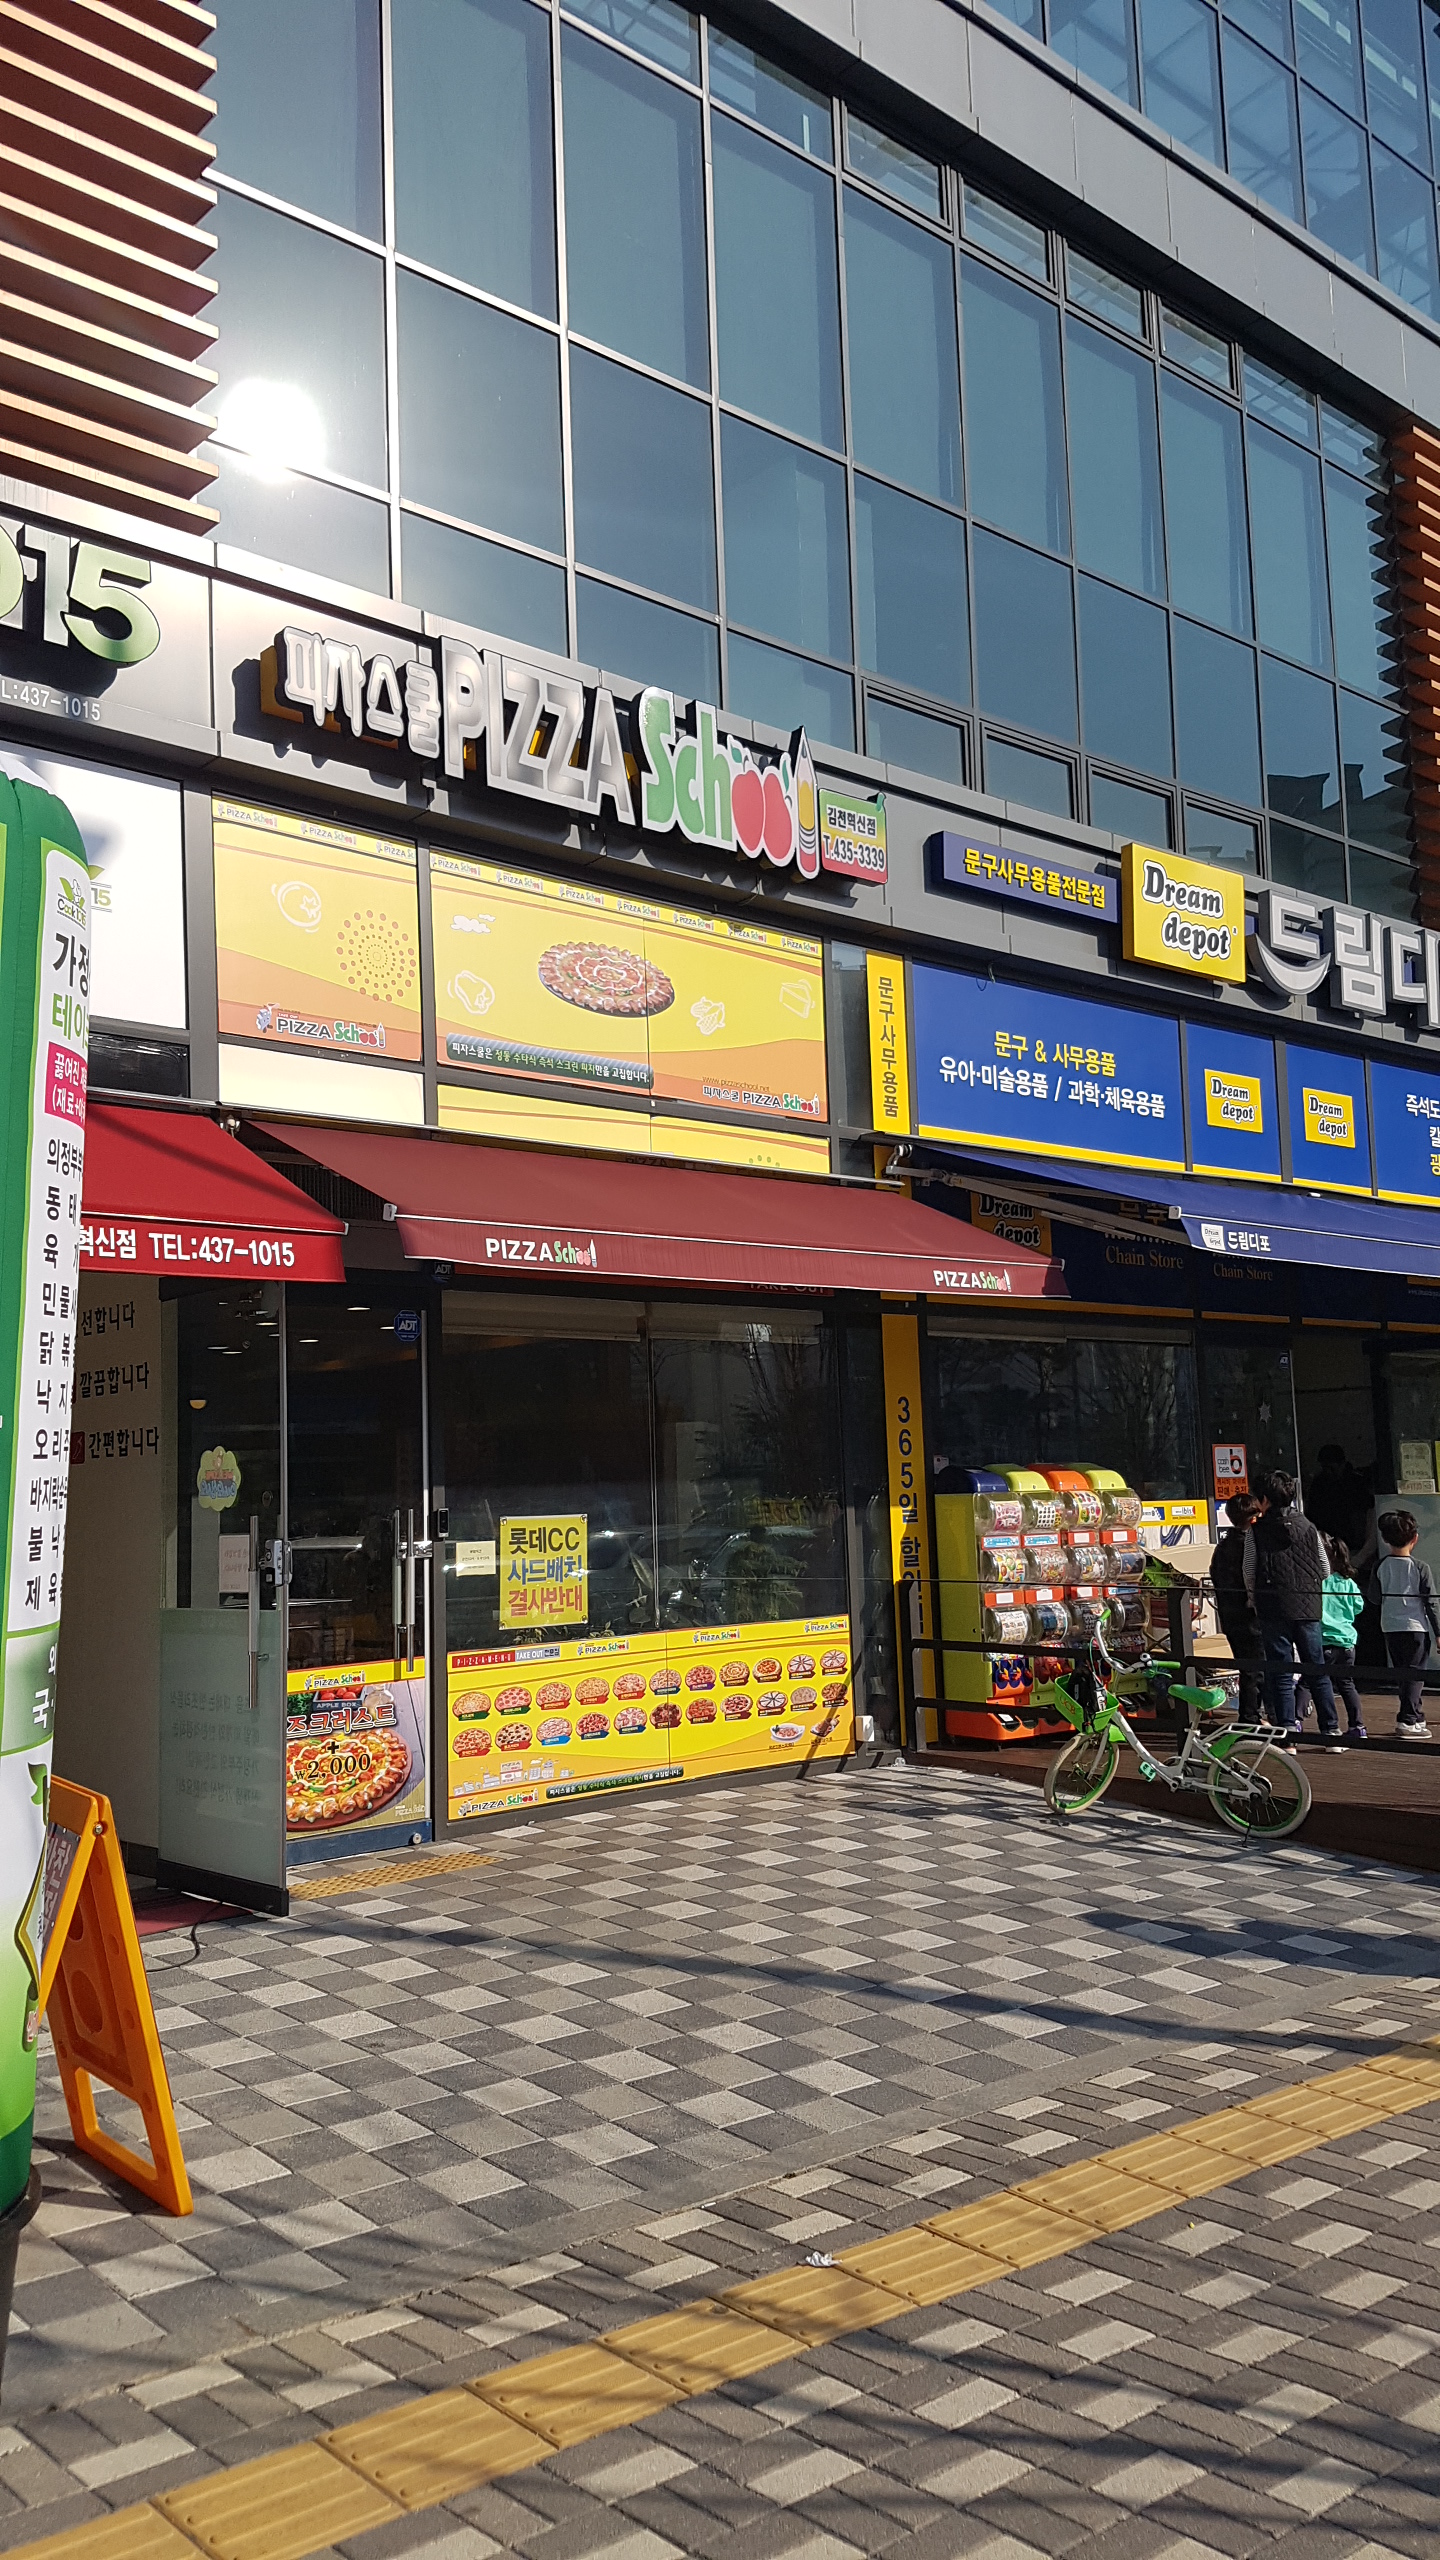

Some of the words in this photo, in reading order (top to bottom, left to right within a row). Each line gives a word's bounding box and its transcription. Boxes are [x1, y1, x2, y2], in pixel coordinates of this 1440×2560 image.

[284, 627, 441, 758] 피자스쿨
[441, 637, 634, 826] PIZZA
[638, 686, 820, 880] School
[226, 807, 252, 821] PIZZA
[826, 805, 878, 838] 김천혁신점
[309, 826, 333, 839] PIZZA
[384, 845, 406, 858] PIZZA
[822, 832, 886, 872] T.435-3339
[438, 859, 459, 871] PIZZA
[503, 875, 523, 886] PIZZA
[963, 847, 1106, 909] 문구사무용품전문점
[1143, 860, 1223, 917] Dream
[91, 887, 112, 907] 15
[565, 889, 585, 901] PIZZA
[623, 903, 641, 914] PIZZA
[787, 940, 803, 950] PIZZA
[1162, 910, 1231, 960] depot
[52, 932, 91, 998] 가정
[277, 1017, 332, 1040] PIZZA
[334, 1021, 385, 1048] School
[877, 976, 899, 1119] 문구사무용품
[994, 1031, 1029, 1058] 문구
[1034, 1039, 1047, 1063] &
[1053, 1042, 1117, 1078] 사무용품
[452, 1042, 493, 1060] 피자스쿨은
[539, 1056, 554, 1069] 즉석
[556, 1059, 579, 1073] 스크린
[612, 1068, 650, 1084] 고집합니다.
[938, 1055, 1049, 1100] 유아·미술용품
[1068, 1078, 1165, 1119] 과학·체육용품
[1210, 1075, 1250, 1101] Dream
[742, 1091, 782, 1108] PIZZA
[783, 1092, 820, 1115] School
[1221, 1101, 1255, 1124] depot
[1308, 1094, 1343, 1118] Dream
[1318, 1119, 1348, 1140] depot
[148, 1231, 296, 1268] TEL:437-1015
[485, 1237, 554, 1262] PIZZA
[554, 1238, 597, 1268] School
[1227, 1231, 1272, 1252] 드림디포
[434, 1264, 452, 1275] ADT
[1105, 1245, 1146, 1269] Chain
[1150, 1252, 1184, 1270] Store
[933, 1269, 981, 1288] PIZZA
[981, 1269, 1012, 1292] School
[1213, 1262, 1244, 1279] Chain
[1246, 1265, 1274, 1282] Store
[80, 1301, 136, 1338] 선합니다
[398, 1319, 417, 1331] ADT
[79, 1361, 150, 1398] 깔끔합니다
[88, 1426, 160, 1460] 간편합니다
[508, 1526, 580, 1555] 롯데CC
[507, 1554, 584, 1585] 사드배치
[508, 1584, 583, 1618] 결사반대
[700, 1634, 720, 1642] PIZZA
[811, 1623, 829, 1632] PIZZA
[532, 1650, 543, 1658] OUT
[585, 1645, 606, 1655] PIZZA
[313, 1677, 340, 1688] PIZZA
[341, 1670, 366, 1684] School
[316, 1701, 340, 1709] APPLE
[341, 1700, 356, 1708] BOX
[287, 1704, 397, 1740] 즈크러스트
[470, 1799, 505, 1813] PIZZA
[506, 1787, 539, 1806] School
